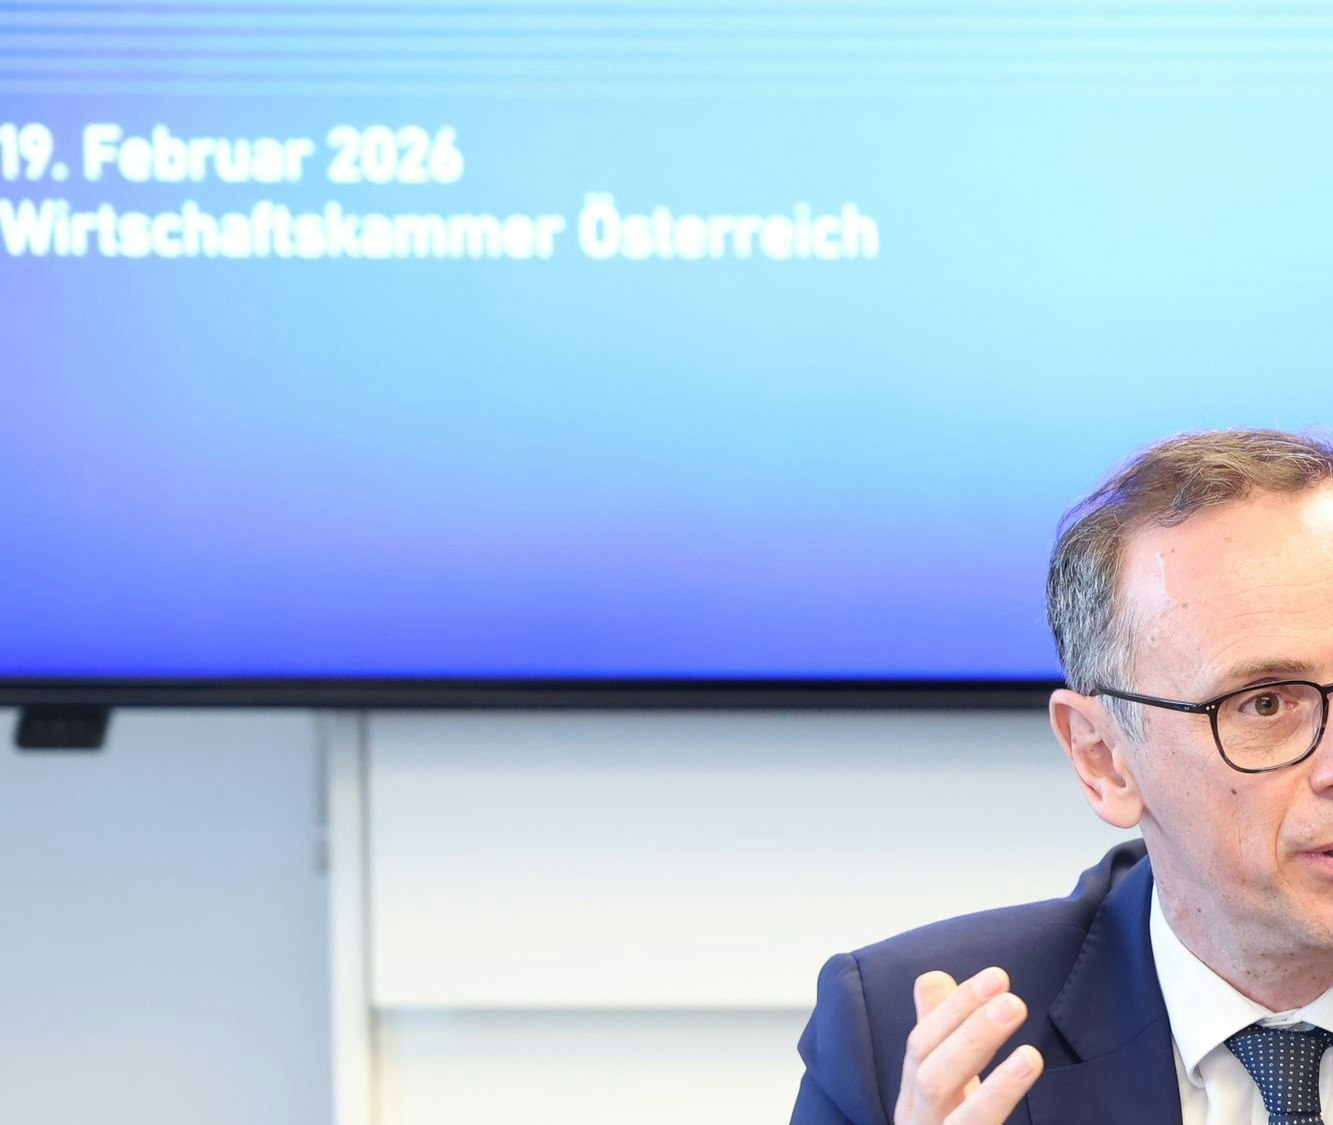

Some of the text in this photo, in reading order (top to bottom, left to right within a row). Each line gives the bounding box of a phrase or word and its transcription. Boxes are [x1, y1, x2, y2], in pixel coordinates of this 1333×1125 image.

[0, 123, 463, 183] 19. Februar 2026
[0, 192, 878, 258] Wirtschaftskammer Österreich
